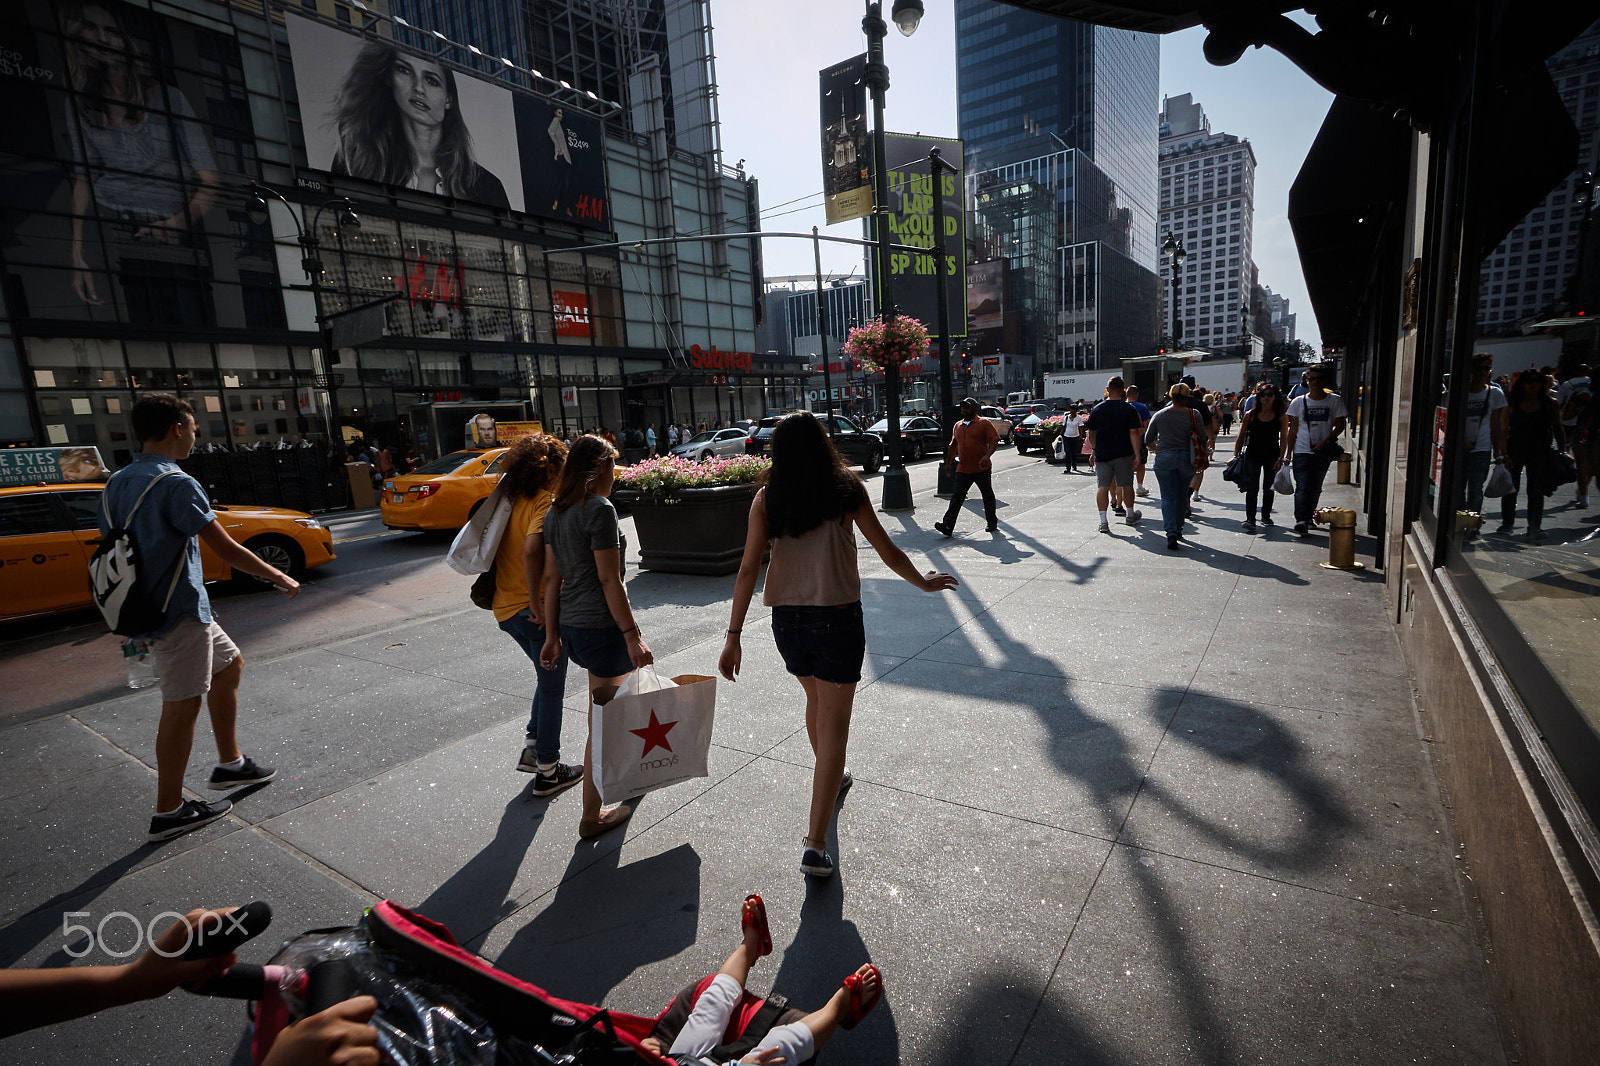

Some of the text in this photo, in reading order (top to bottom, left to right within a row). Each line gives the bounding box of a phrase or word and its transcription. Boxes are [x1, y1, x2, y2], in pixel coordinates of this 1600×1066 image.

[902, 193, 934, 214] LAP
[888, 212, 957, 236] AROUD
[899, 234, 936, 255] YOU
[891, 253, 956, 275] SPRINS
[691, 344, 752, 373] Subway
[14, 452, 56, 466] EYES
[26, 465, 57, 474] CLUB
